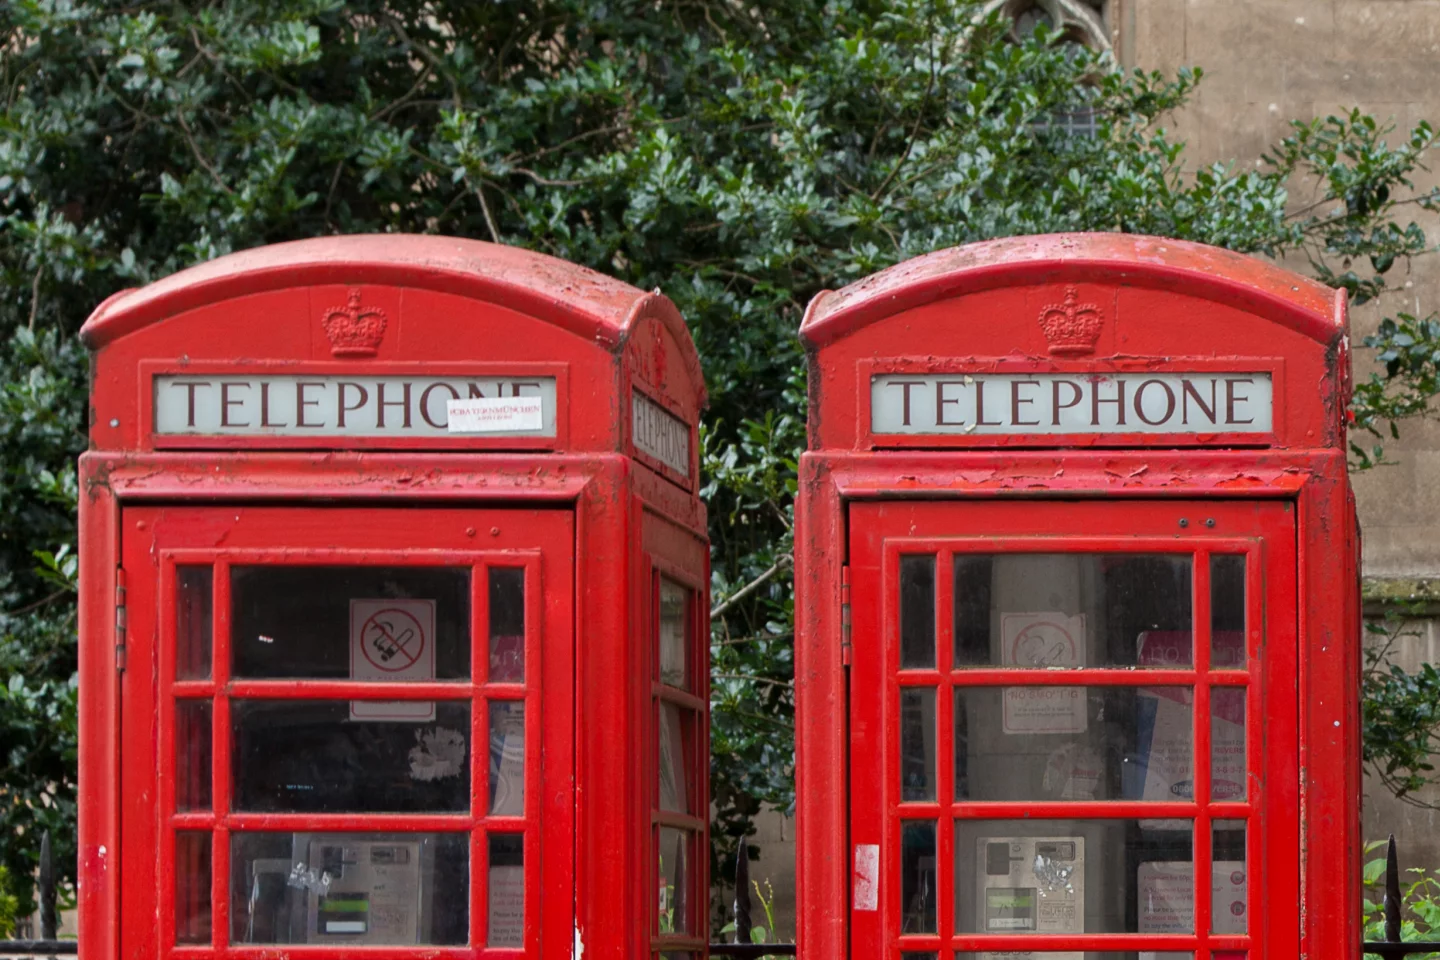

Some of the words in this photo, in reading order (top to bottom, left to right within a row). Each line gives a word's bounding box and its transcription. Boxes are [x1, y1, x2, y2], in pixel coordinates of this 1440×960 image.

[171, 381, 541, 428] TELEPHO
[886, 378, 1254, 426] TELEPHONE
[636, 396, 689, 470] ELEPHONE
